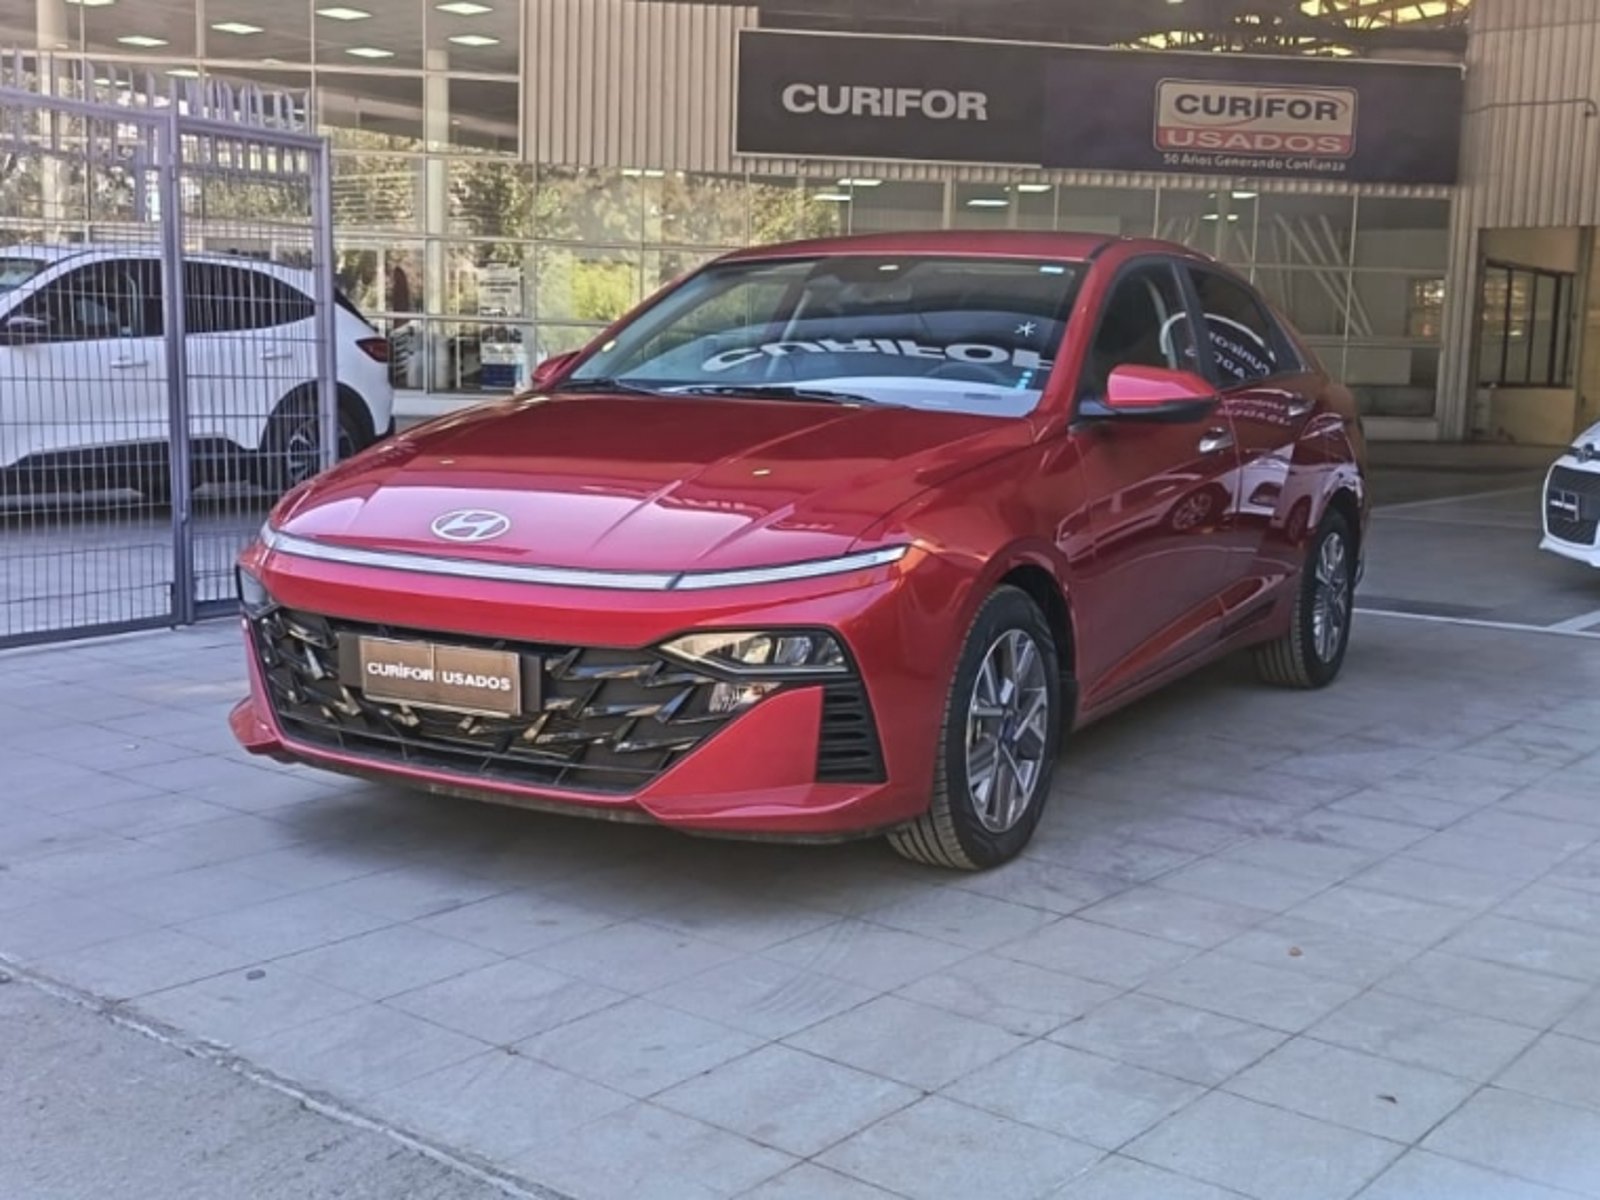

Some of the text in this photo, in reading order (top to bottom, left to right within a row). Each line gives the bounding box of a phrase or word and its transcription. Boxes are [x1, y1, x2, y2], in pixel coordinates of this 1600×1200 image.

[782, 83, 988, 121] CURIFOR
[1174, 93, 1338, 121] CURIFOR
[1166, 130, 1342, 152] USADOS
[442, 671, 511, 691] USADOS
